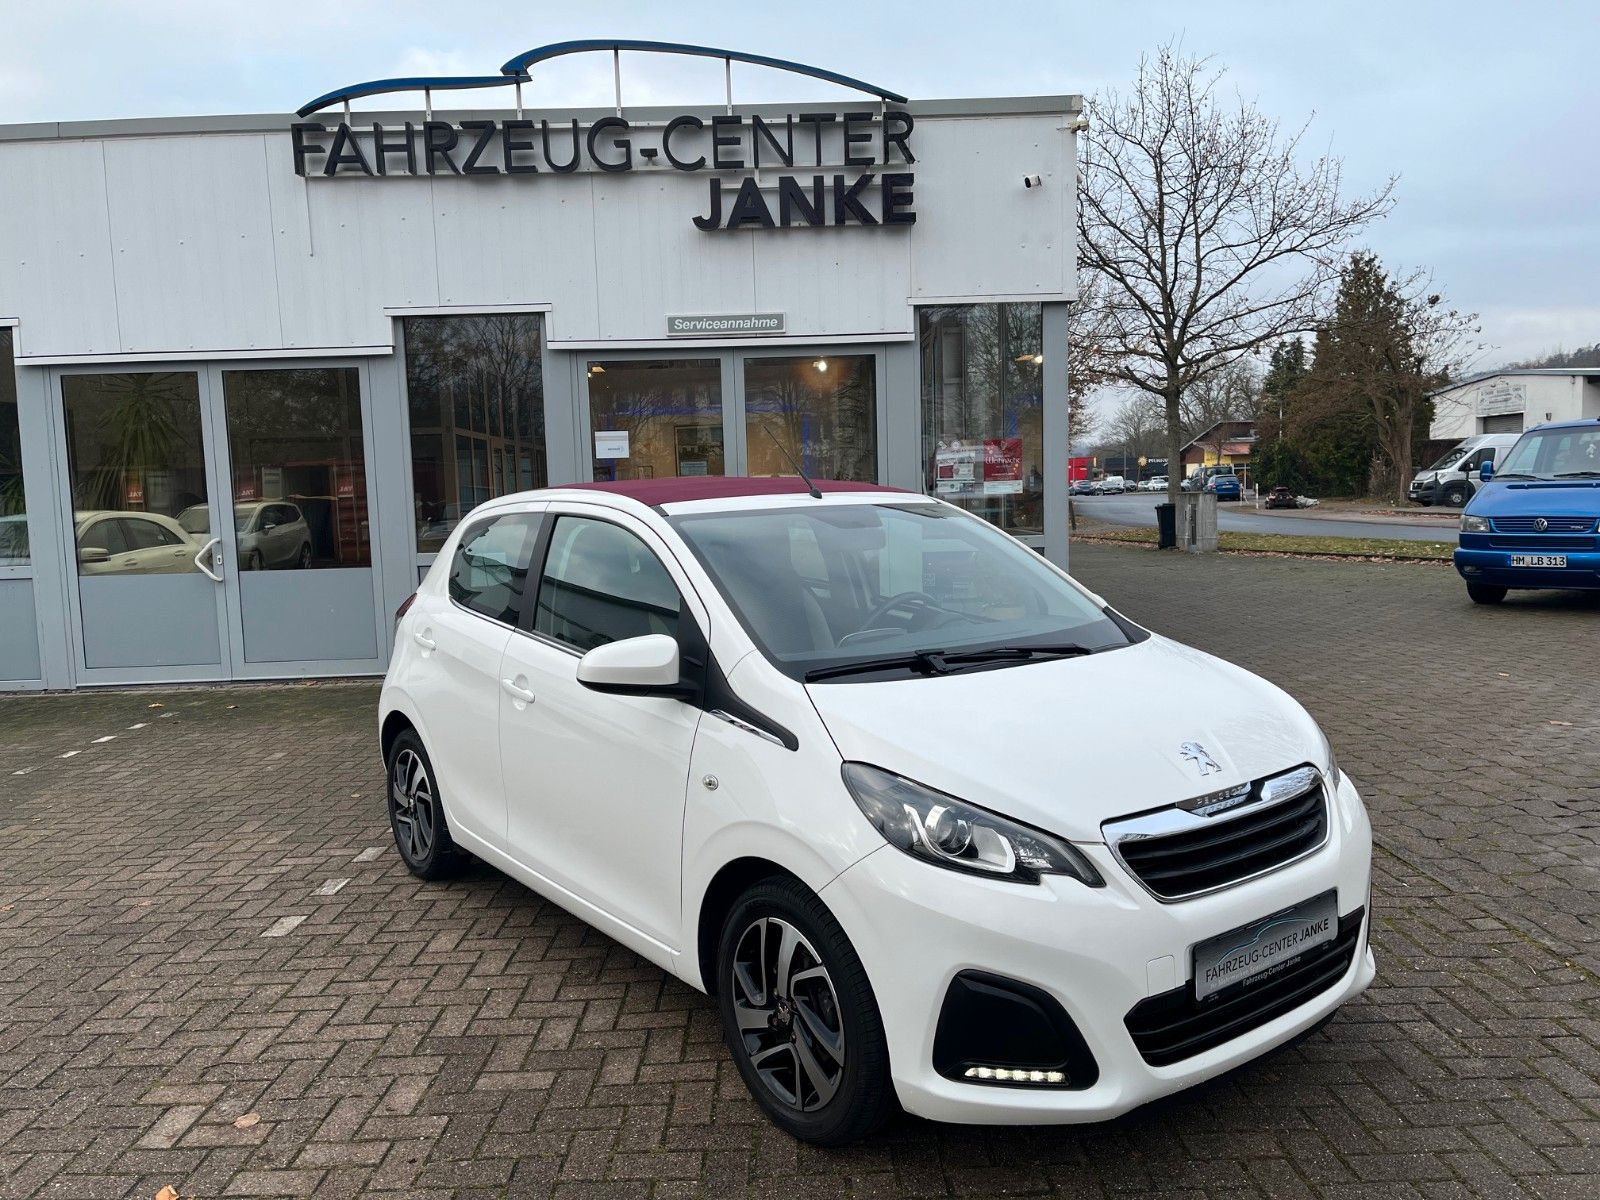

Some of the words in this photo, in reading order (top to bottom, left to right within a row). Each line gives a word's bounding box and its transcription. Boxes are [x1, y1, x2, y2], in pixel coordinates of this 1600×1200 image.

[291, 111, 916, 177] FAHRZEUG-CENTER
[692, 173, 916, 231] JANKE
[674, 317, 778, 330] Serviceannahme
[1511, 556, 1525, 565] HM
[1530, 556, 1544, 566] LB
[1546, 556, 1566, 566] 313
[1205, 932, 1298, 983] FAHRZEUG-CENTER
[1299, 918, 1330, 942] JANKE
